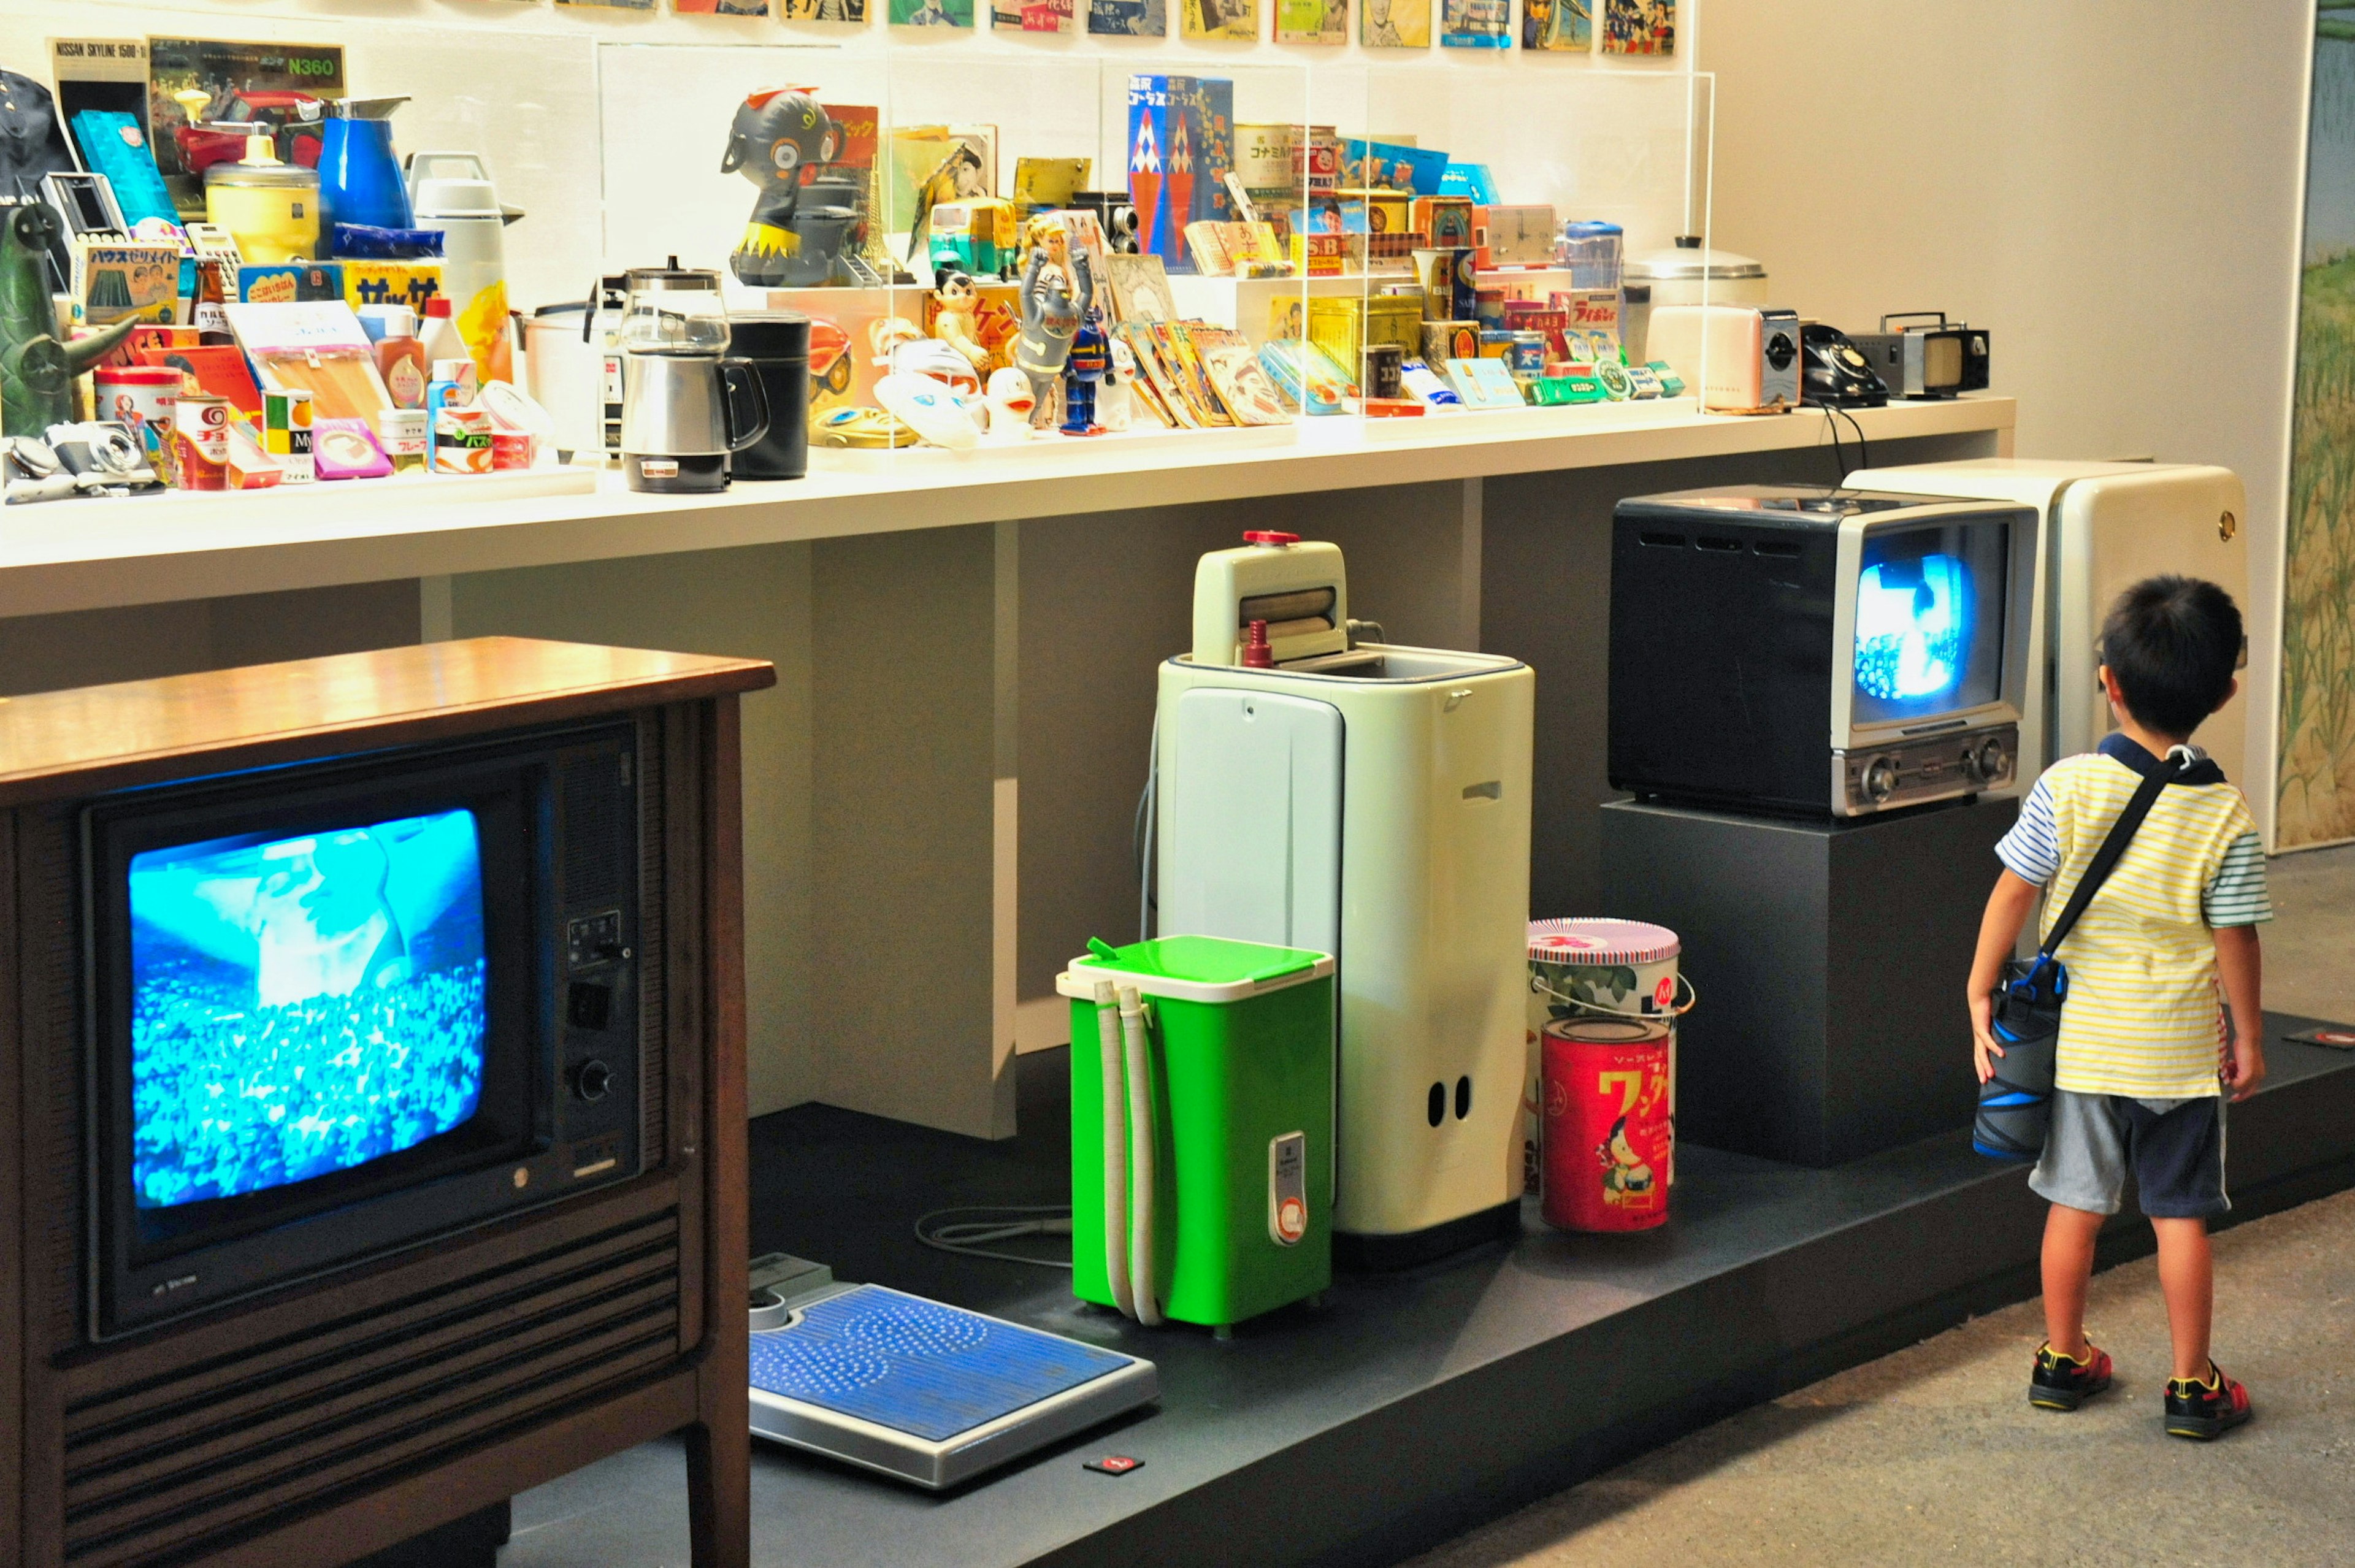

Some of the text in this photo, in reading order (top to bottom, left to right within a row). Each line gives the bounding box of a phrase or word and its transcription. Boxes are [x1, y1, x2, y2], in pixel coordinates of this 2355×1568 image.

[56, 42, 84, 56] NISSAN
[88, 44, 116, 58] SKYLINE
[288, 58, 334, 76] N360
